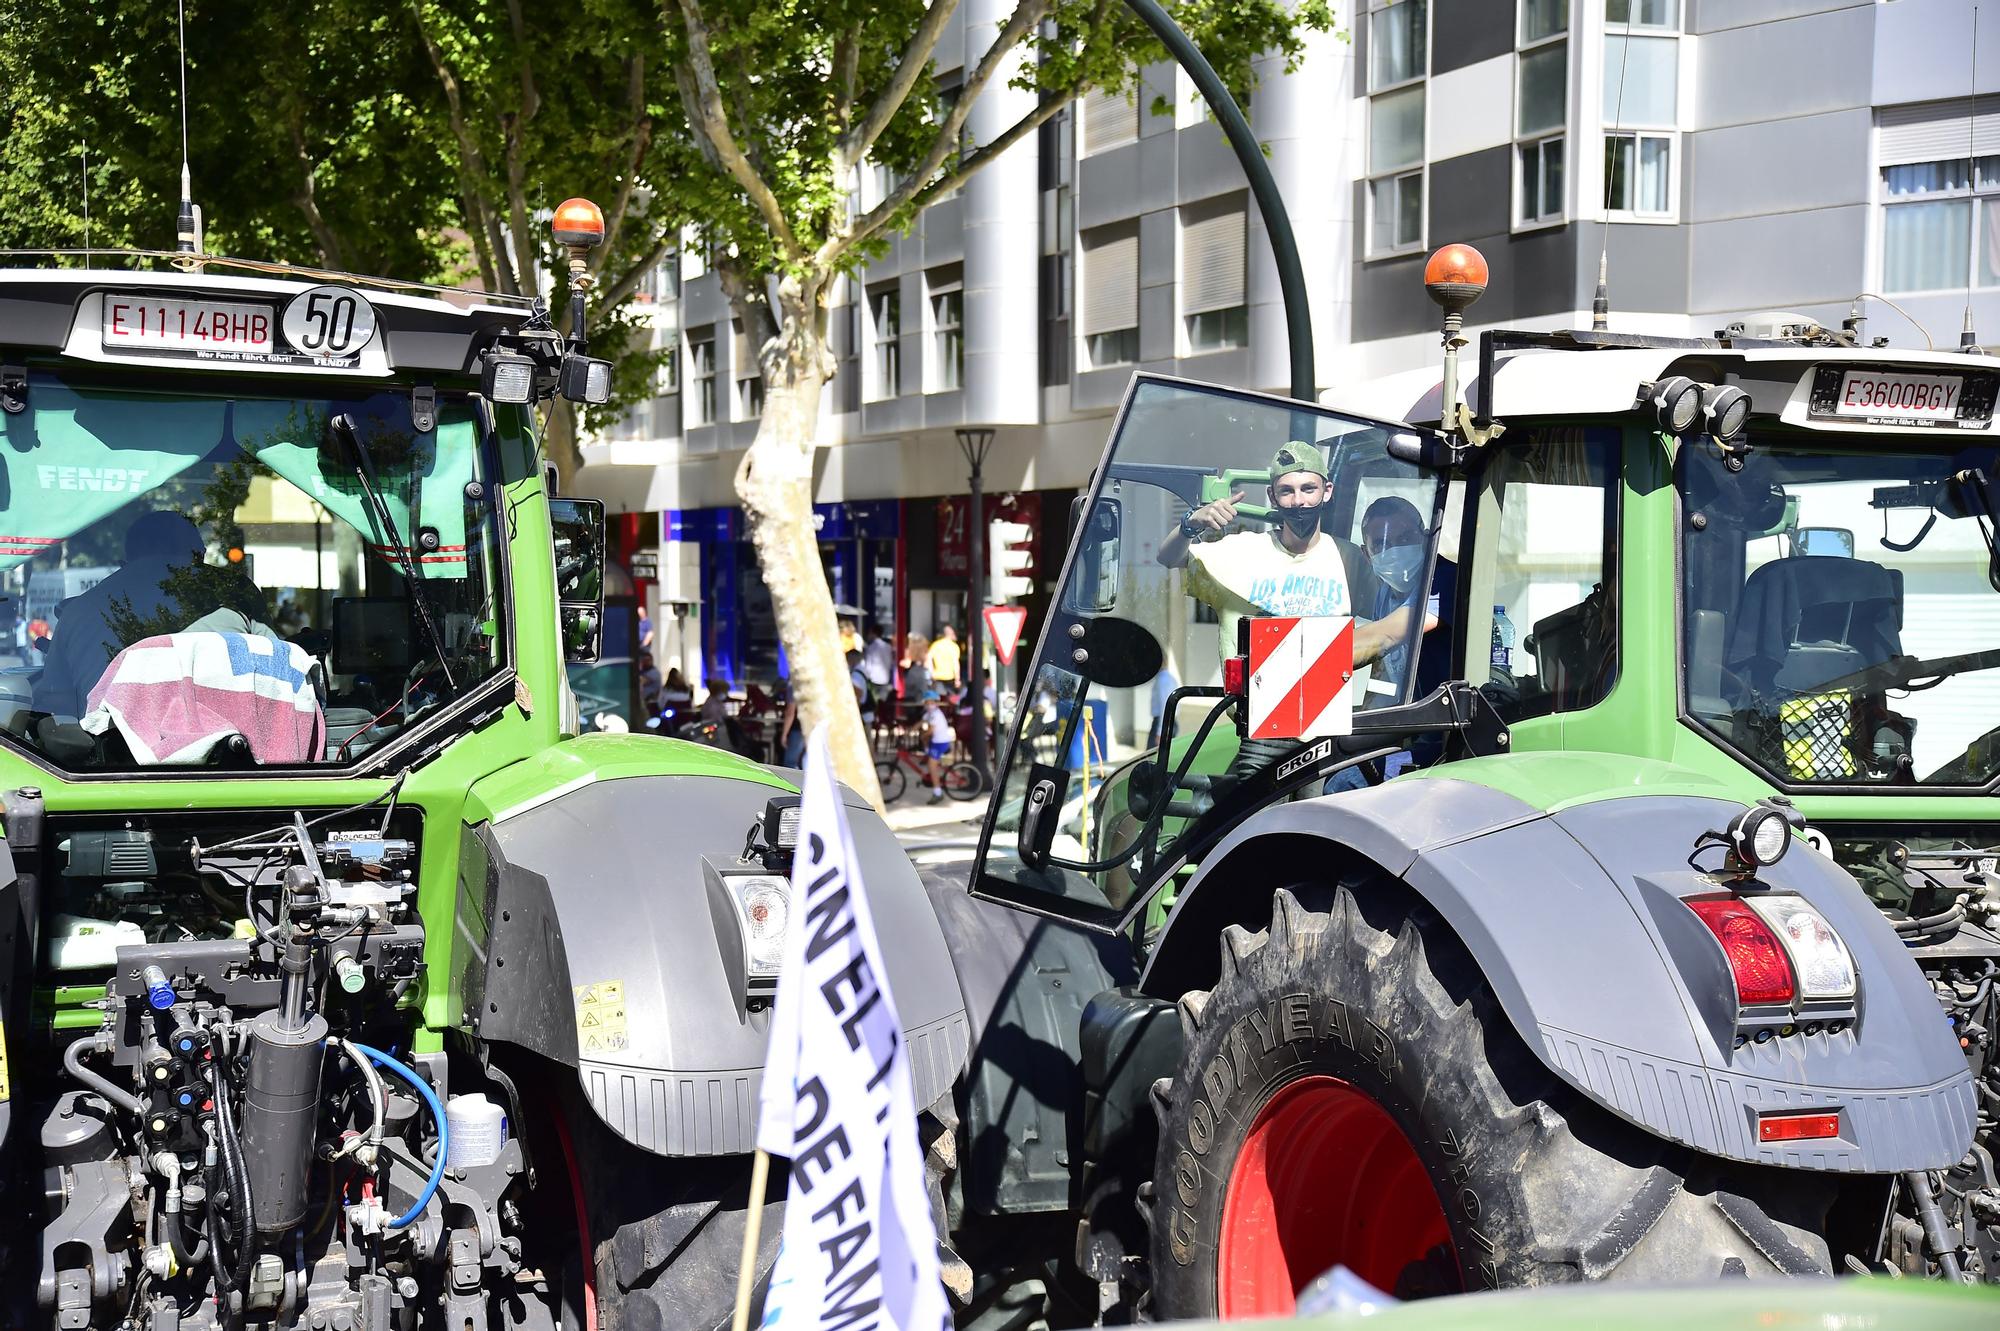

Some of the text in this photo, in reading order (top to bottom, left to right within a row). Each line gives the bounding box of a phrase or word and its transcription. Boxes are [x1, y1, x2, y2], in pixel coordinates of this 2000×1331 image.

[113, 304, 268, 344] E1114BHB
[302, 293, 357, 351] 50
[197, 351, 214, 359] Wer
[216, 352, 240, 360] Fendt
[313, 357, 352, 367] FENDT
[1844, 380, 1957, 410] E3600BGY
[1957, 421, 1986, 429] FENDT
[36, 464, 150, 493] FENDT
[1250, 574, 1343, 606] LOS ANGELES
[1278, 742, 1330, 777] PROFI
[820, 950, 882, 1052] EL
[794, 1075, 851, 1196] DE
[1169, 993, 1397, 1266] GOODYEAR
